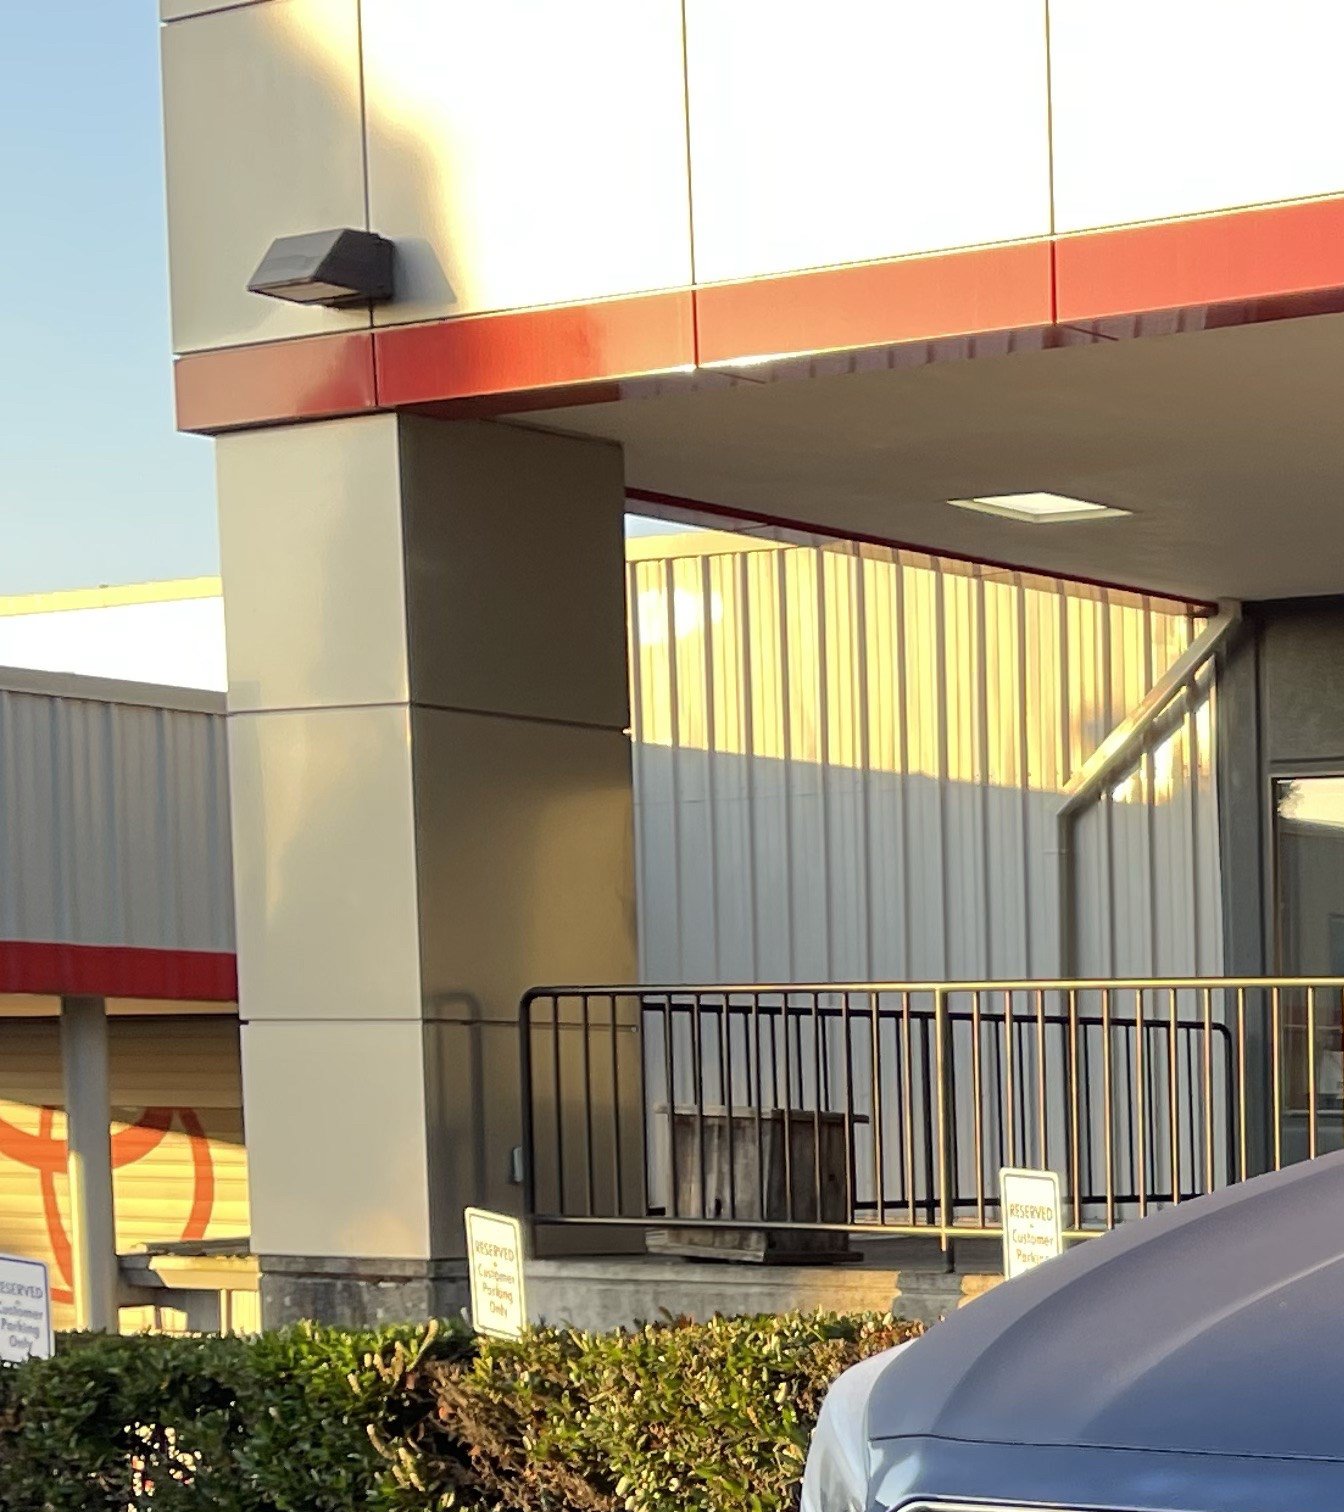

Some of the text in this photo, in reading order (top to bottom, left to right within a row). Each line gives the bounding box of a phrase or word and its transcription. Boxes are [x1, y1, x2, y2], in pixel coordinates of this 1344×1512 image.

[1009, 1203, 1053, 1221] RESERVED
[1012, 1228, 1053, 1247] Customer
[475, 1240, 515, 1262] RESERVED
[477, 1263, 515, 1285] Customer
[0, 1280, 43, 1299] ESERVED
[482, 1282, 513, 1304] Parking
[0, 1305, 43, 1320] ustomer
[489, 1300, 508, 1319] Only
[1, 1317, 40, 1339] Parking
[9, 1334, 33, 1355] Only
